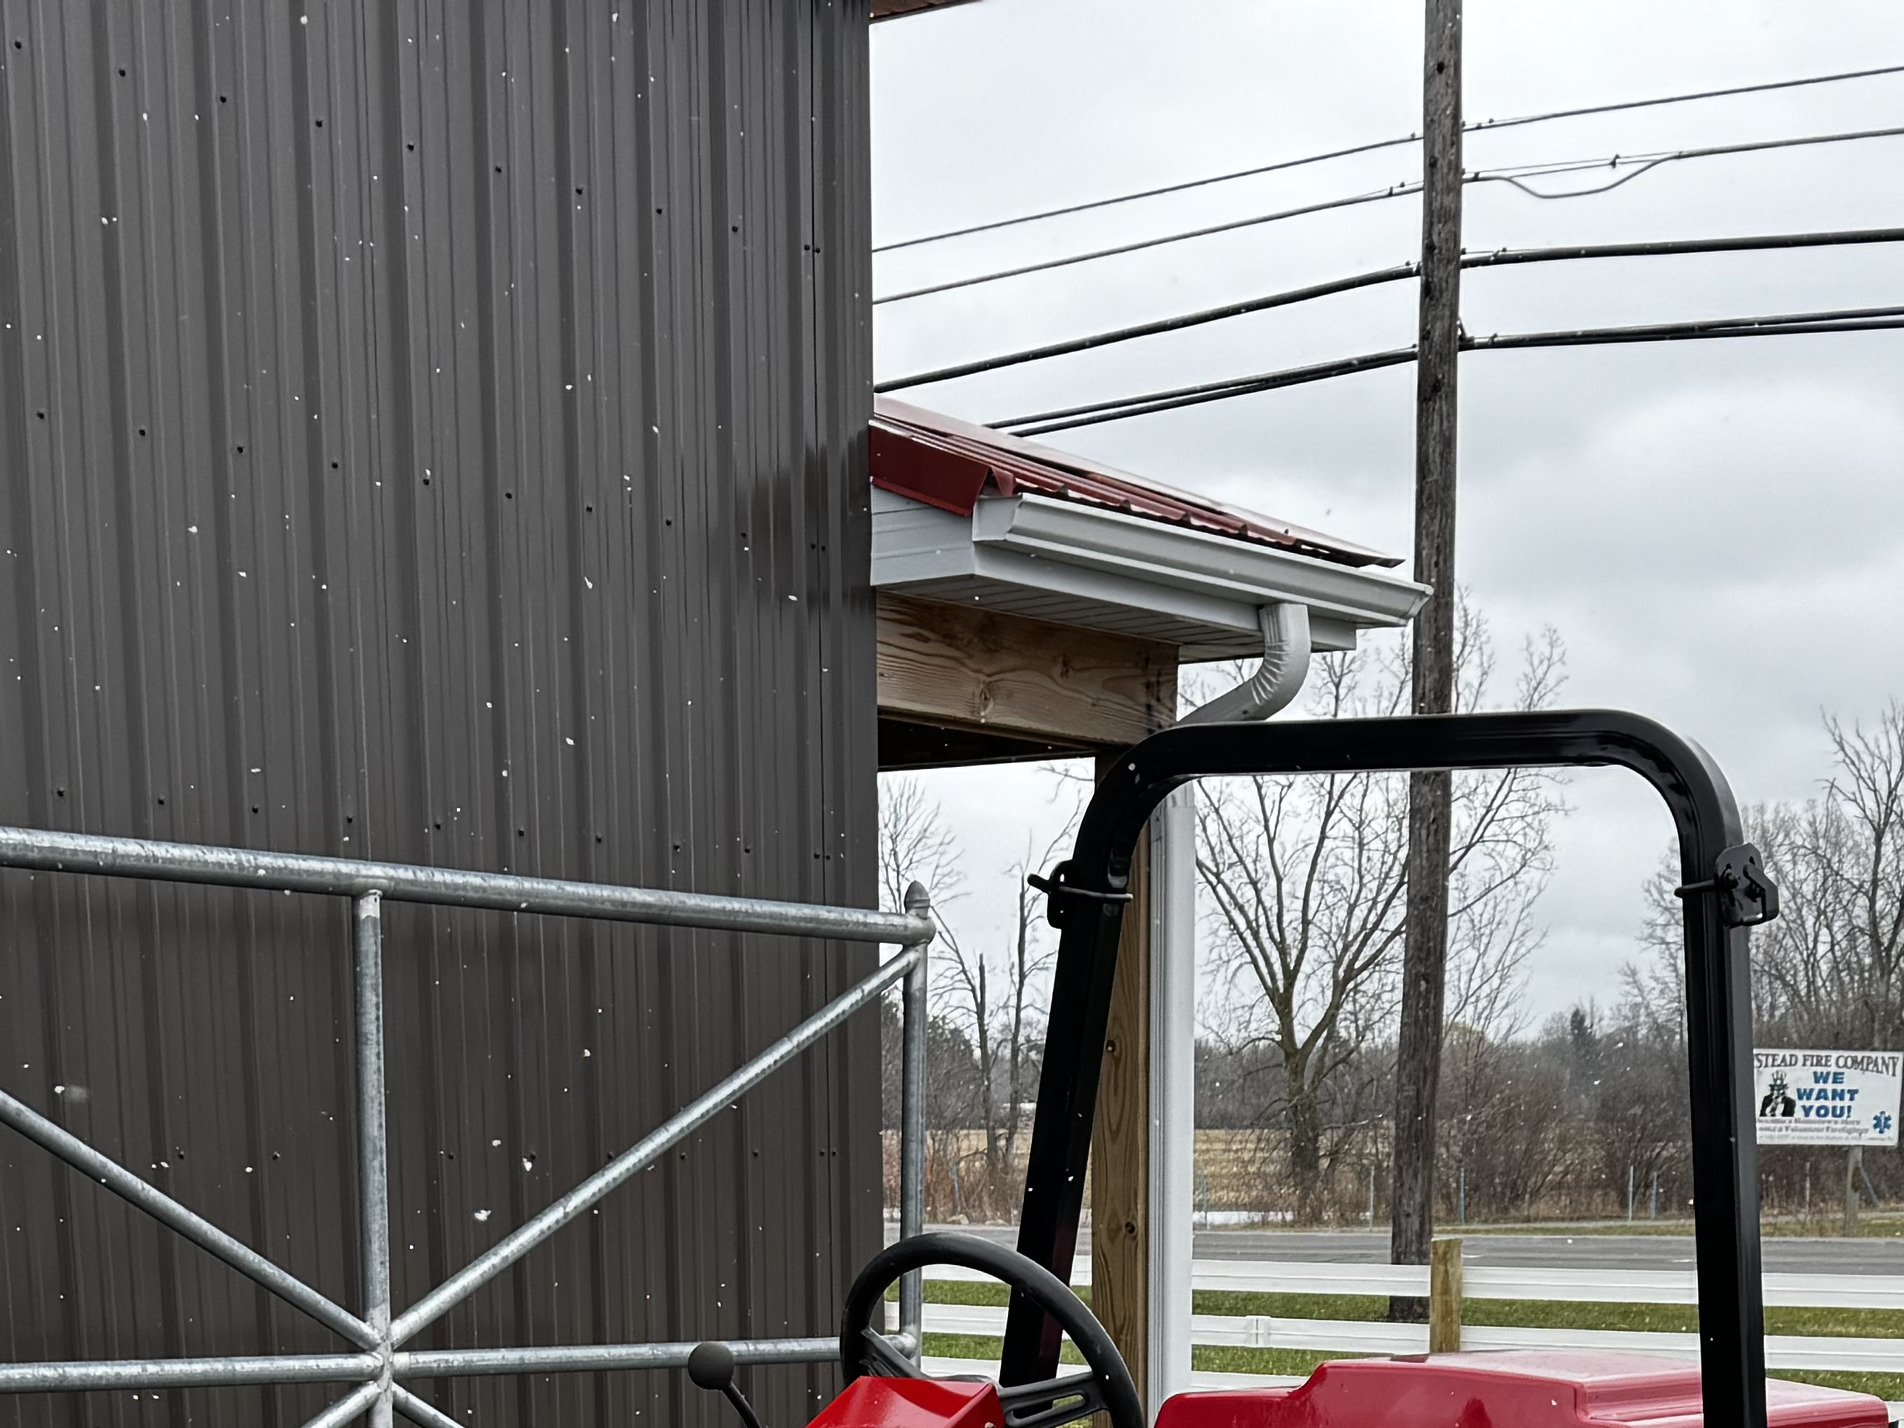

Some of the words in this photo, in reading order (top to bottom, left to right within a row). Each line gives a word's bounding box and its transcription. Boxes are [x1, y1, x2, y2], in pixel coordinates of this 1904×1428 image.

[1802, 1054, 1832, 1068] FIRE
[1836, 1055, 1899, 1077] COMPANY
[1813, 1071, 1845, 1084] WE
[1796, 1088, 1859, 1102] WANT
[1801, 1105, 1852, 1119] YOU!
